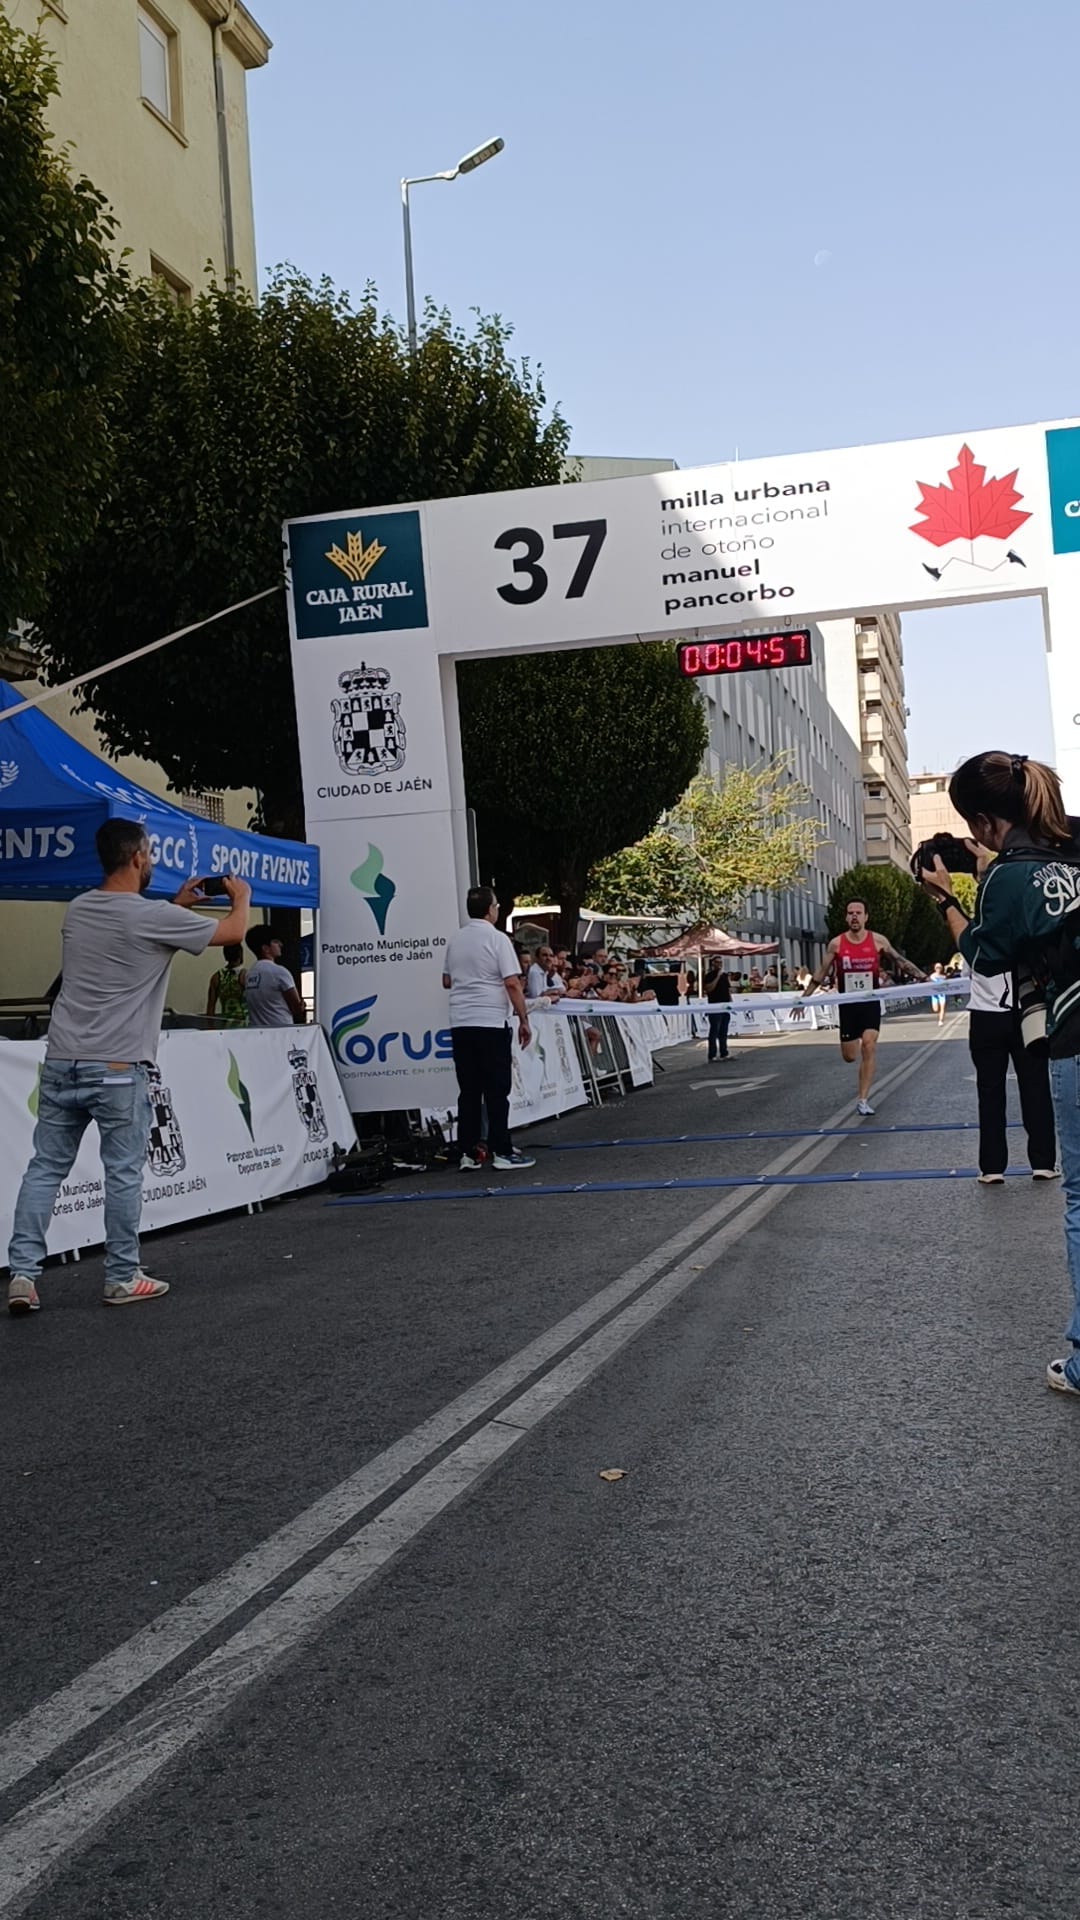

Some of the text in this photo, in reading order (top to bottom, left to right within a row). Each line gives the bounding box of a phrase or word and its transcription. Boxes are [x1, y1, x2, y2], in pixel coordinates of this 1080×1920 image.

[661, 479, 831, 513] milla urbana
[661, 500, 829, 536] internacional
[661, 534, 775, 561] de otoño
[494, 519, 608, 606] 37
[662, 558, 761, 586] manuel
[306, 581, 413, 606] CAJA RURAL
[664, 583, 795, 616] pancorbo
[339, 603, 383, 624] JAÉN
[685, 636, 807, 674] 00:04:57
[317, 777, 433, 799] CIUDAD DE JAÉN
[149, 834, 186, 869] GCC
[211, 843, 311, 887] SPORT EVENTS
[321, 936, 446, 954] Patronato Municipal de
[337, 949, 433, 966] Deportes de Jaén
[428, 1065, 456, 1073] FORM
[62, 1178, 102, 1197] Municipal
[174, 1181, 186, 1196] DE
[52, 1202, 73, 1216] ortes
[74, 1198, 85, 1211] de
